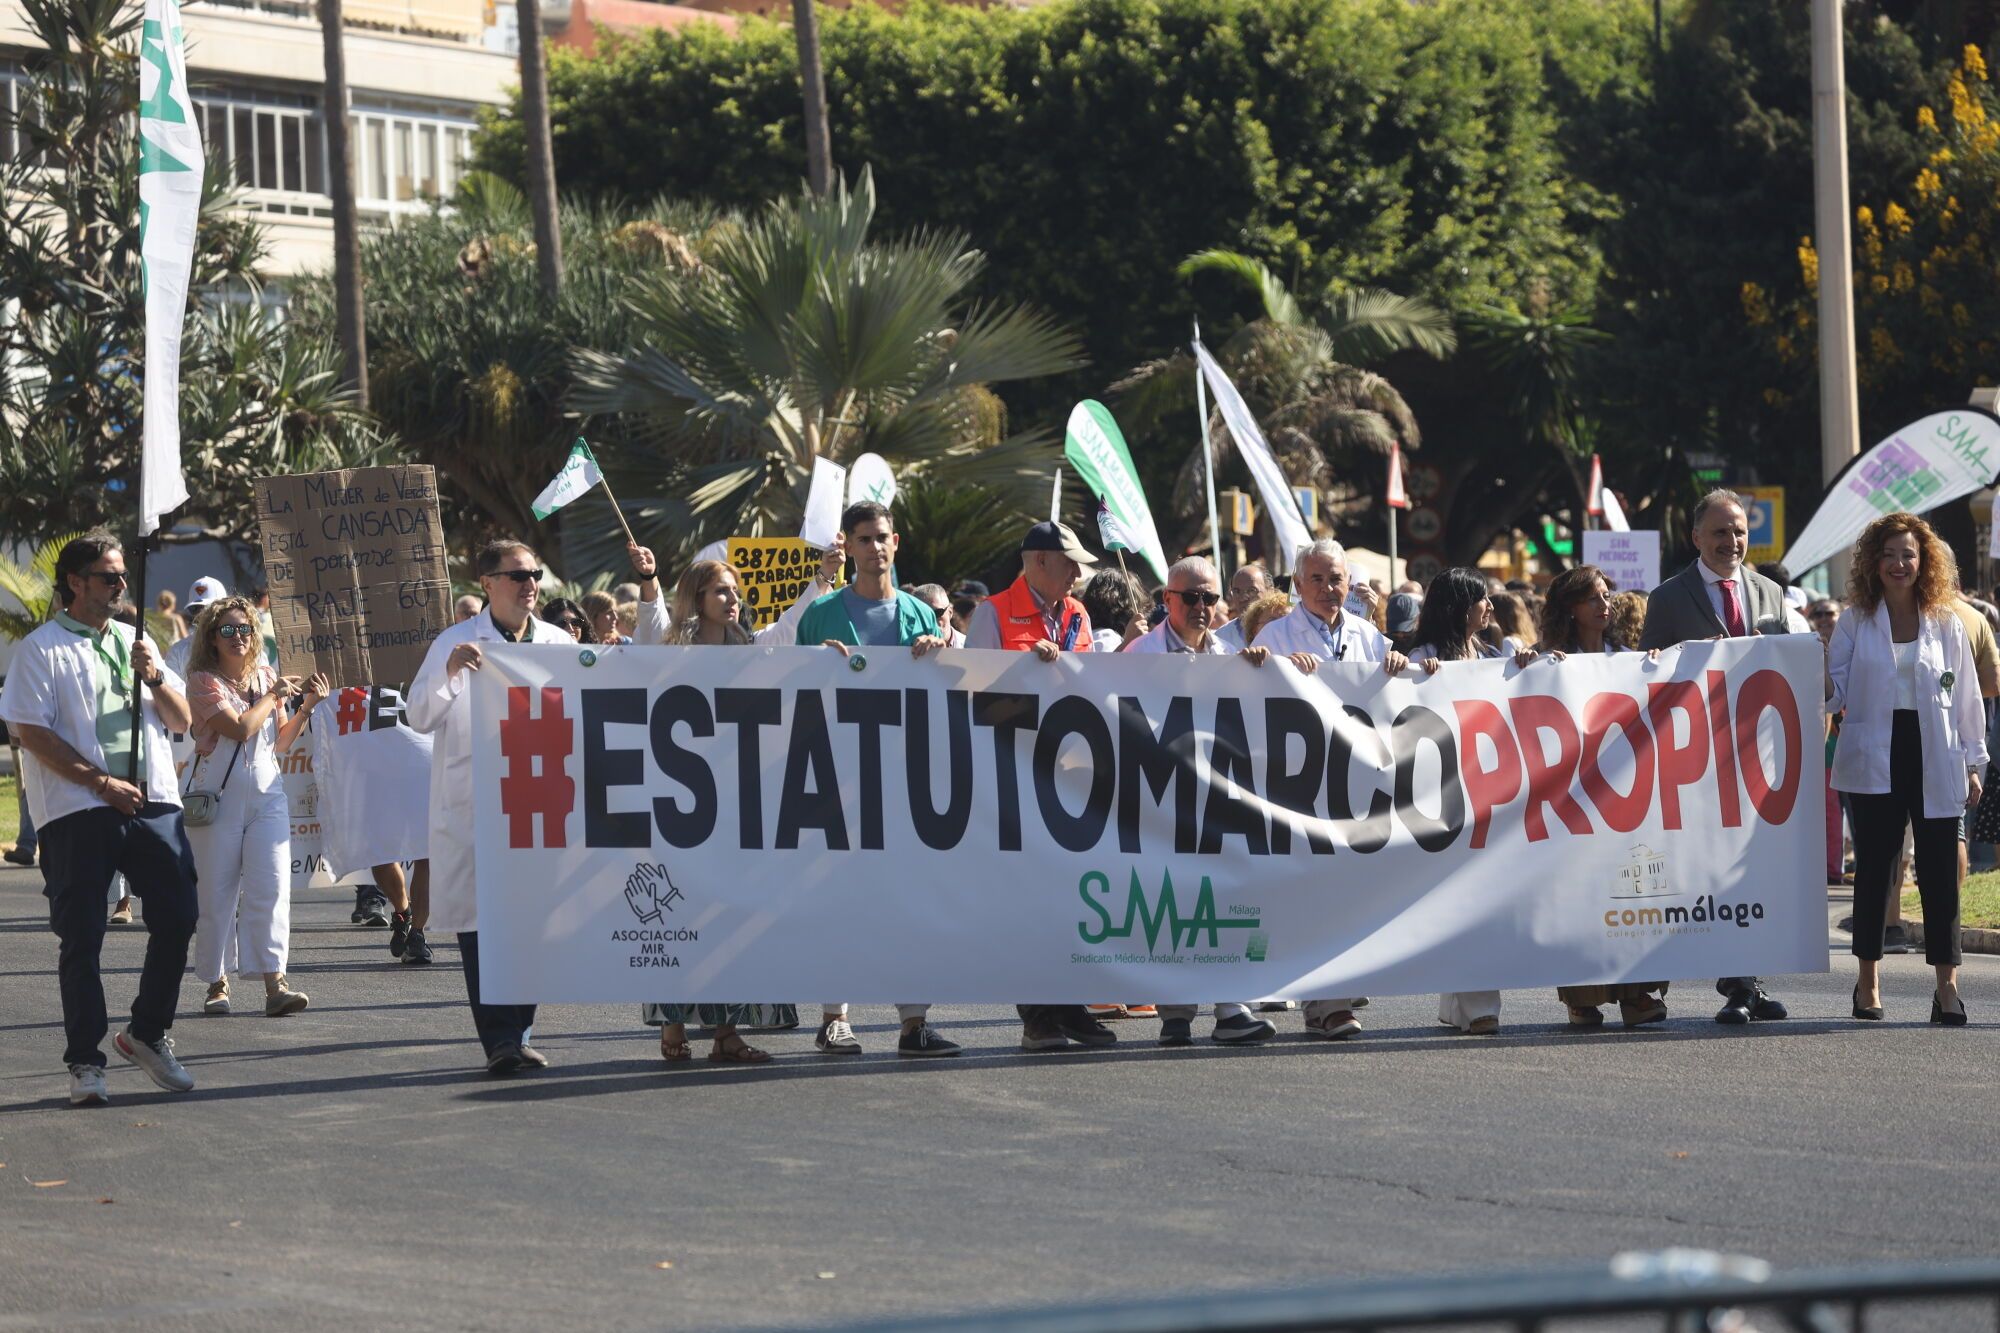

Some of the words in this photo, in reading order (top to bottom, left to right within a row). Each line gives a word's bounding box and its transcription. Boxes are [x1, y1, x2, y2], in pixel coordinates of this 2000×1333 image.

[304, 476, 364, 510] MUJER
[374, 488, 390, 502] de
[392, 472, 432, 500] Verde
[322, 507, 430, 541] CANSADA
[274, 562, 294, 581] DE
[412, 544, 433, 562] EL
[734, 547, 801, 569] 38700
[804, 547, 823, 562] HO
[279, 586, 372, 623] TRAJE
[399, 579, 430, 609] 60
[290, 633, 344, 654] HORAS
[356, 618, 440, 650] Semanales
[499, 668, 1803, 855] #ESTATUTOMARCOPROPIO
[1078, 864, 1260, 955] SMA
[1229, 903, 1261, 916] Málaga
[1604, 894, 1764, 928] commálaga
[611, 926, 699, 942] ASOCIACIÓN
[641, 943, 665, 955] MIR
[629, 954, 681, 968] ESPAÑA
[1071, 953, 1112, 964] Sindicato
[1114, 953, 1146, 964] Médico
[1148, 953, 1184, 964] Andaluz
[1193, 952, 1241, 964] Federación
